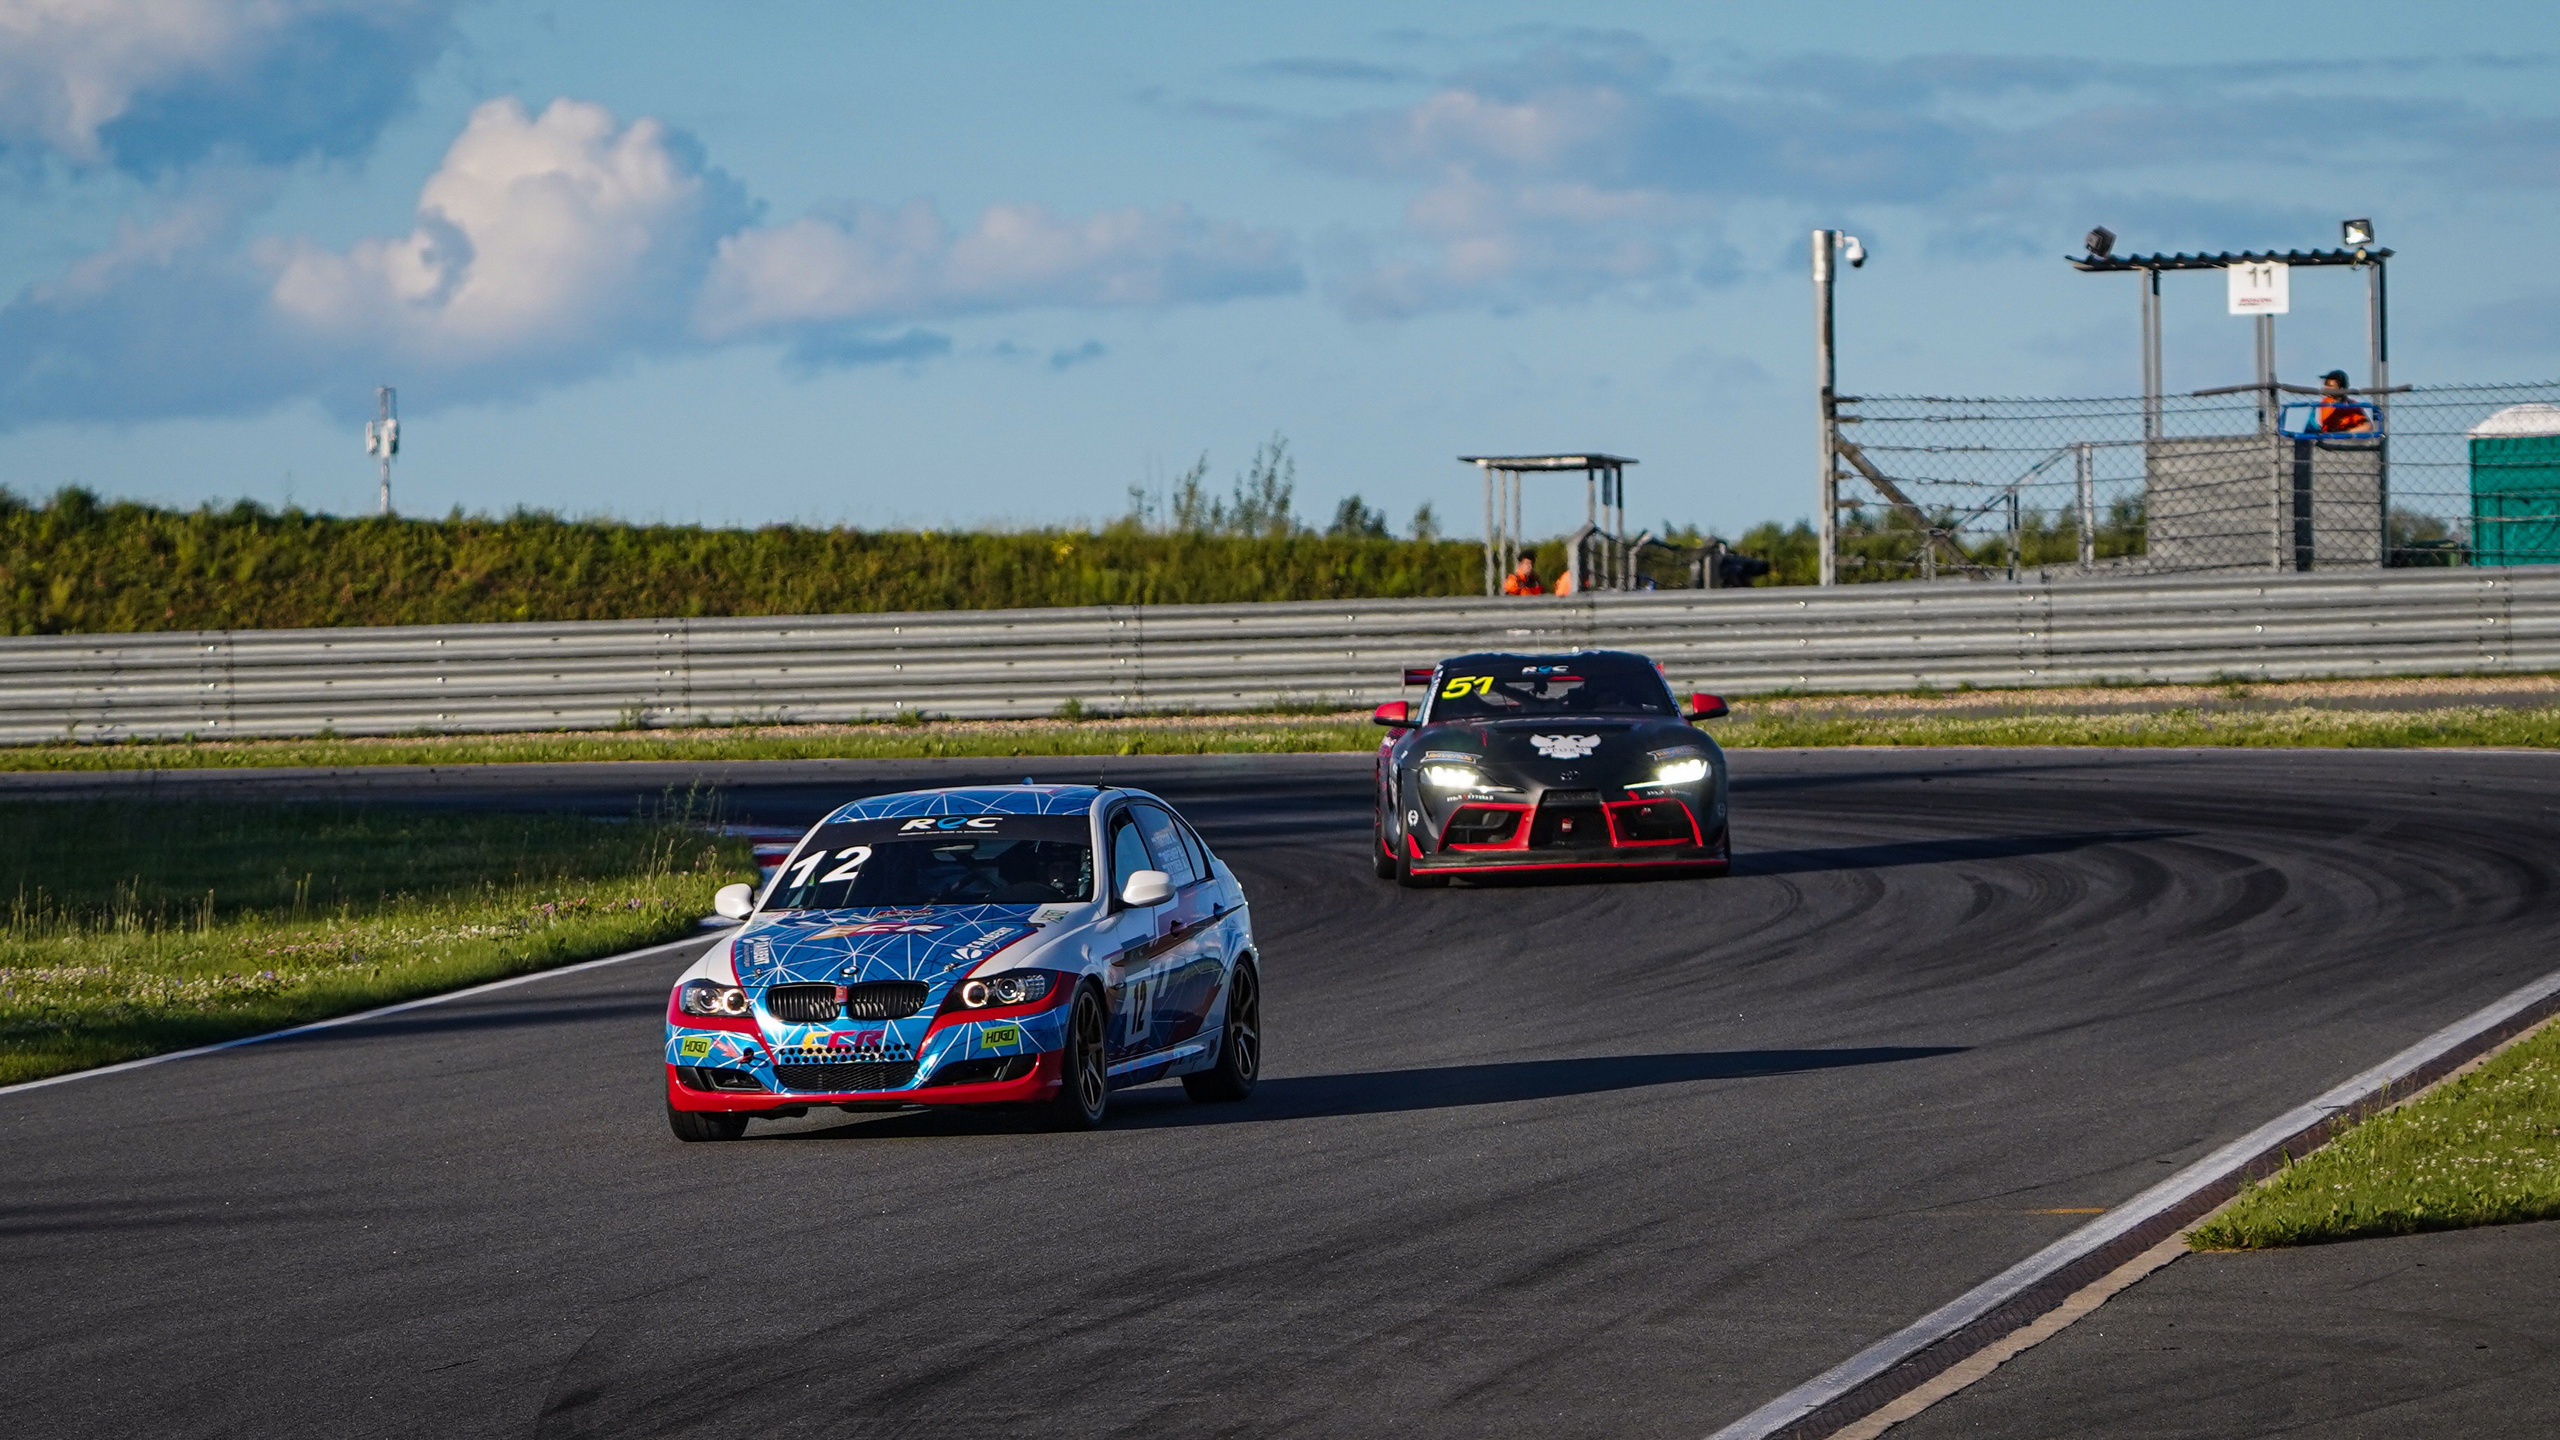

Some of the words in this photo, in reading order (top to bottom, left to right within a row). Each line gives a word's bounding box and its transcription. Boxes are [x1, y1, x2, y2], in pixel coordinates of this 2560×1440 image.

[2247, 266, 2273, 288] 11
[1441, 676, 1494, 699] 51
[789, 845, 873, 889] 12
[1131, 980, 1148, 1035] 12
[684, 1040, 708, 1054] HOGO
[986, 1029, 1015, 1044] HOGO
